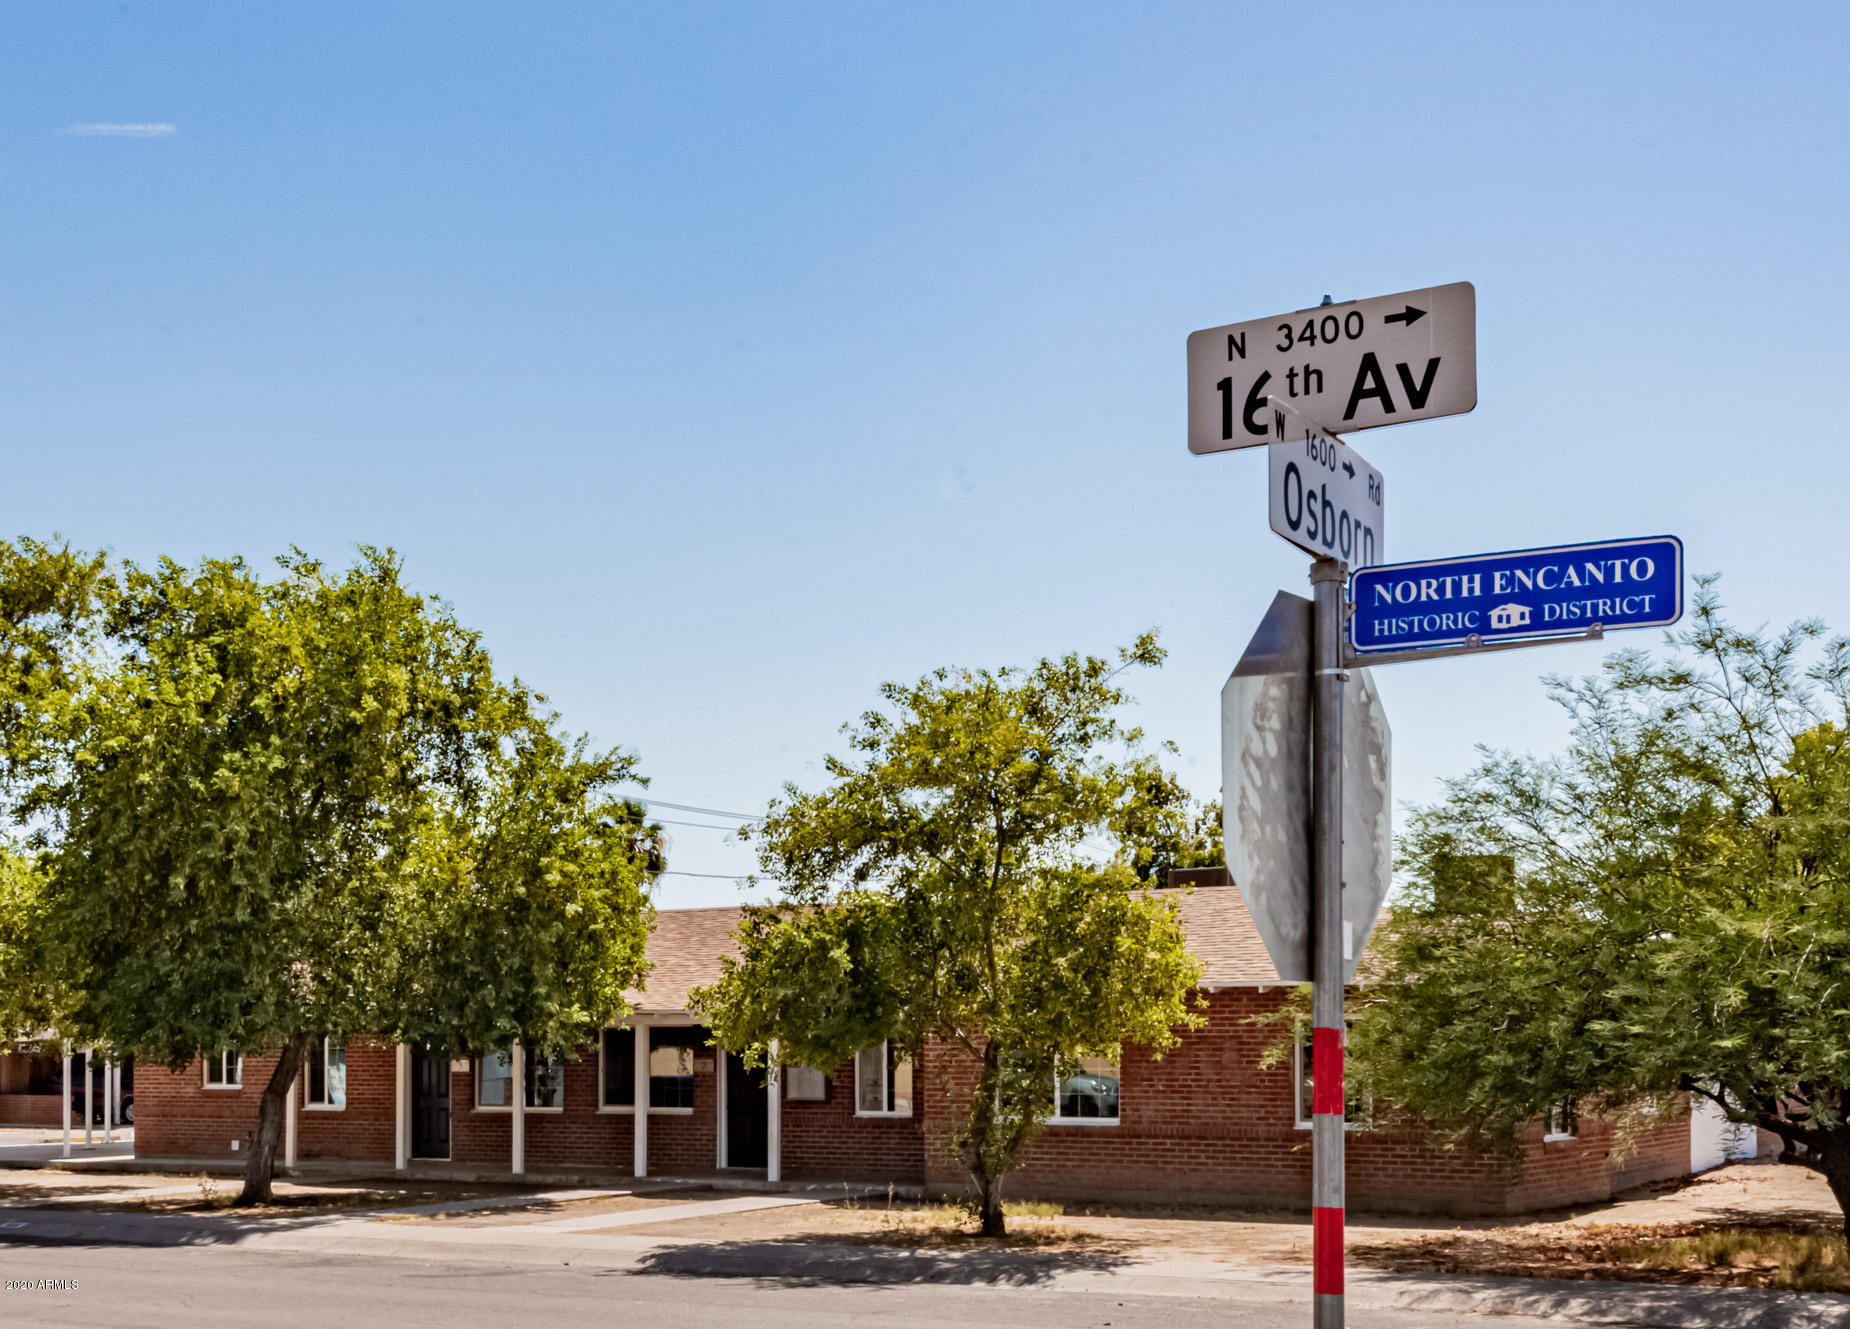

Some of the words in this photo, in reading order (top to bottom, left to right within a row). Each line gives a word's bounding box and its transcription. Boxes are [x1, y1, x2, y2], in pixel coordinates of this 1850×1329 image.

[1228, 331, 1246, 362] N
[1275, 310, 1364, 353] 3400
[1342, 351, 1442, 421] Av
[1275, 409, 1285, 441] W
[1305, 428, 1336, 472] 1600
[1283, 461, 1375, 568] Osborn
[1368, 473, 1381, 506] Rd
[1373, 573, 1482, 607] NORTH
[1492, 556, 1655, 595] ENCANTO
[1373, 610, 1480, 637] HISTORIC
[1543, 595, 1656, 622] DISTRICT
